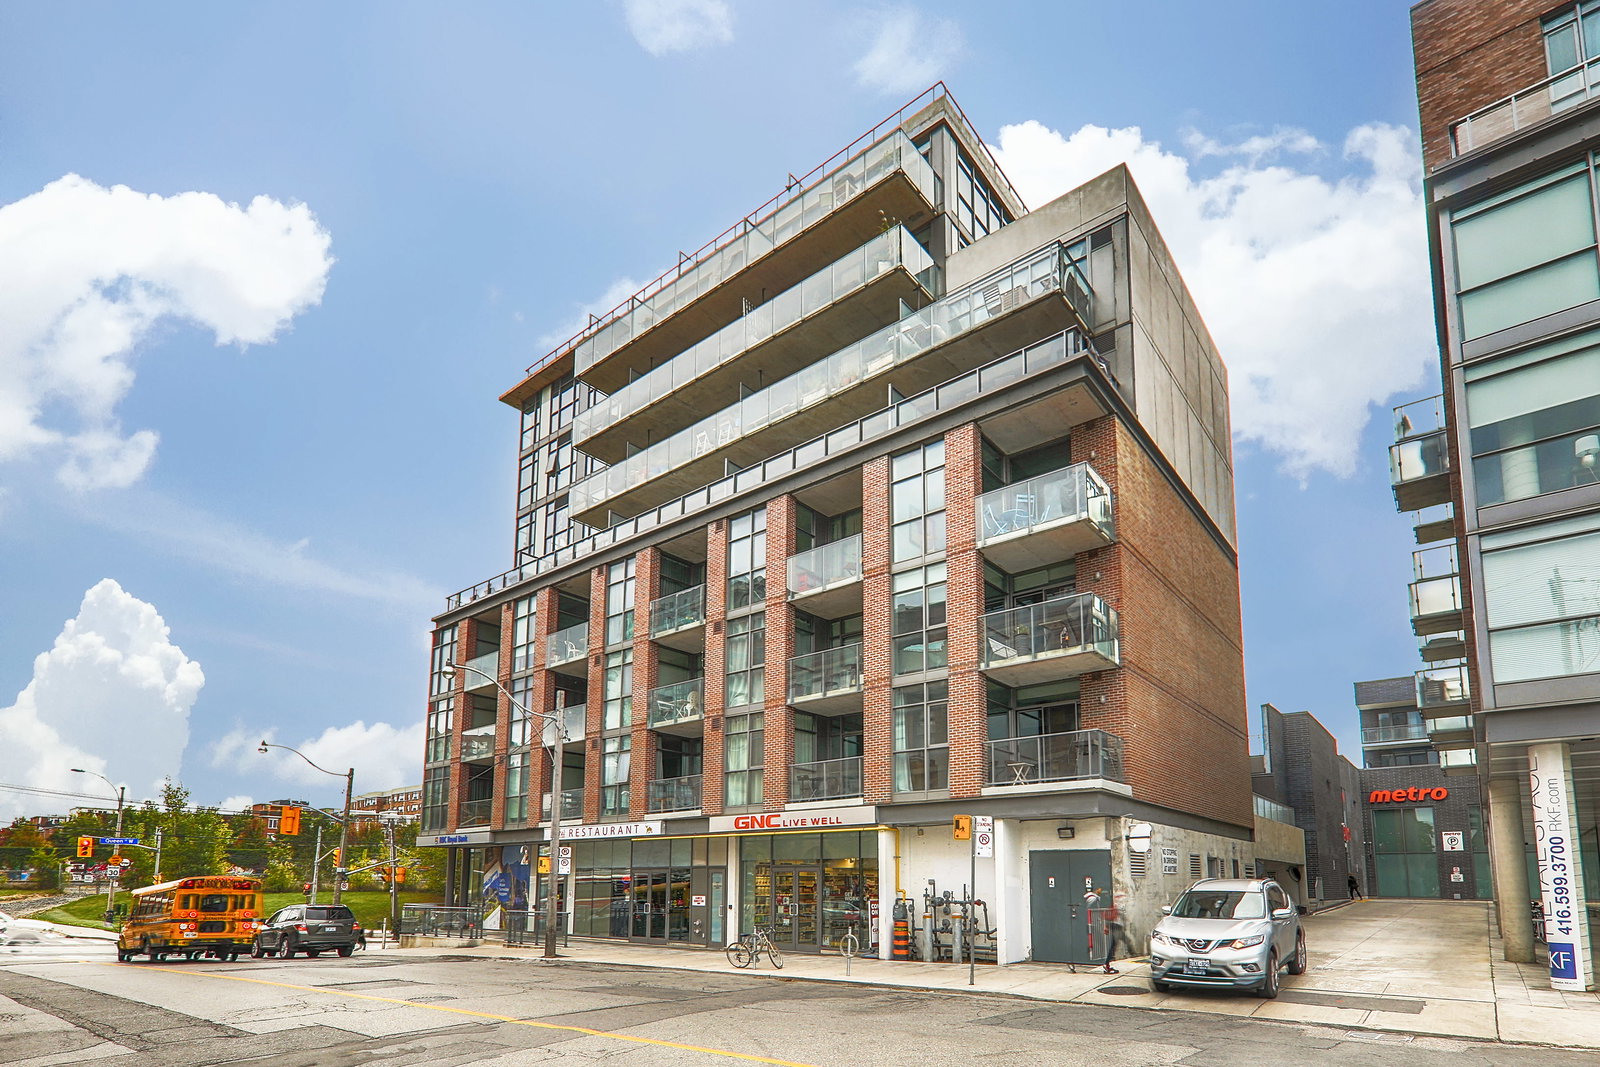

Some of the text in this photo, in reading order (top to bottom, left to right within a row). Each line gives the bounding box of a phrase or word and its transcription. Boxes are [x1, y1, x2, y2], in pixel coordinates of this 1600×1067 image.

[1369, 786, 1448, 803] metro
[734, 814, 842, 829] GNC LIVE WELL
[568, 824, 640, 838] RESTAURANT
[1546, 778, 1574, 936] 416.599.3700 RKF.com
